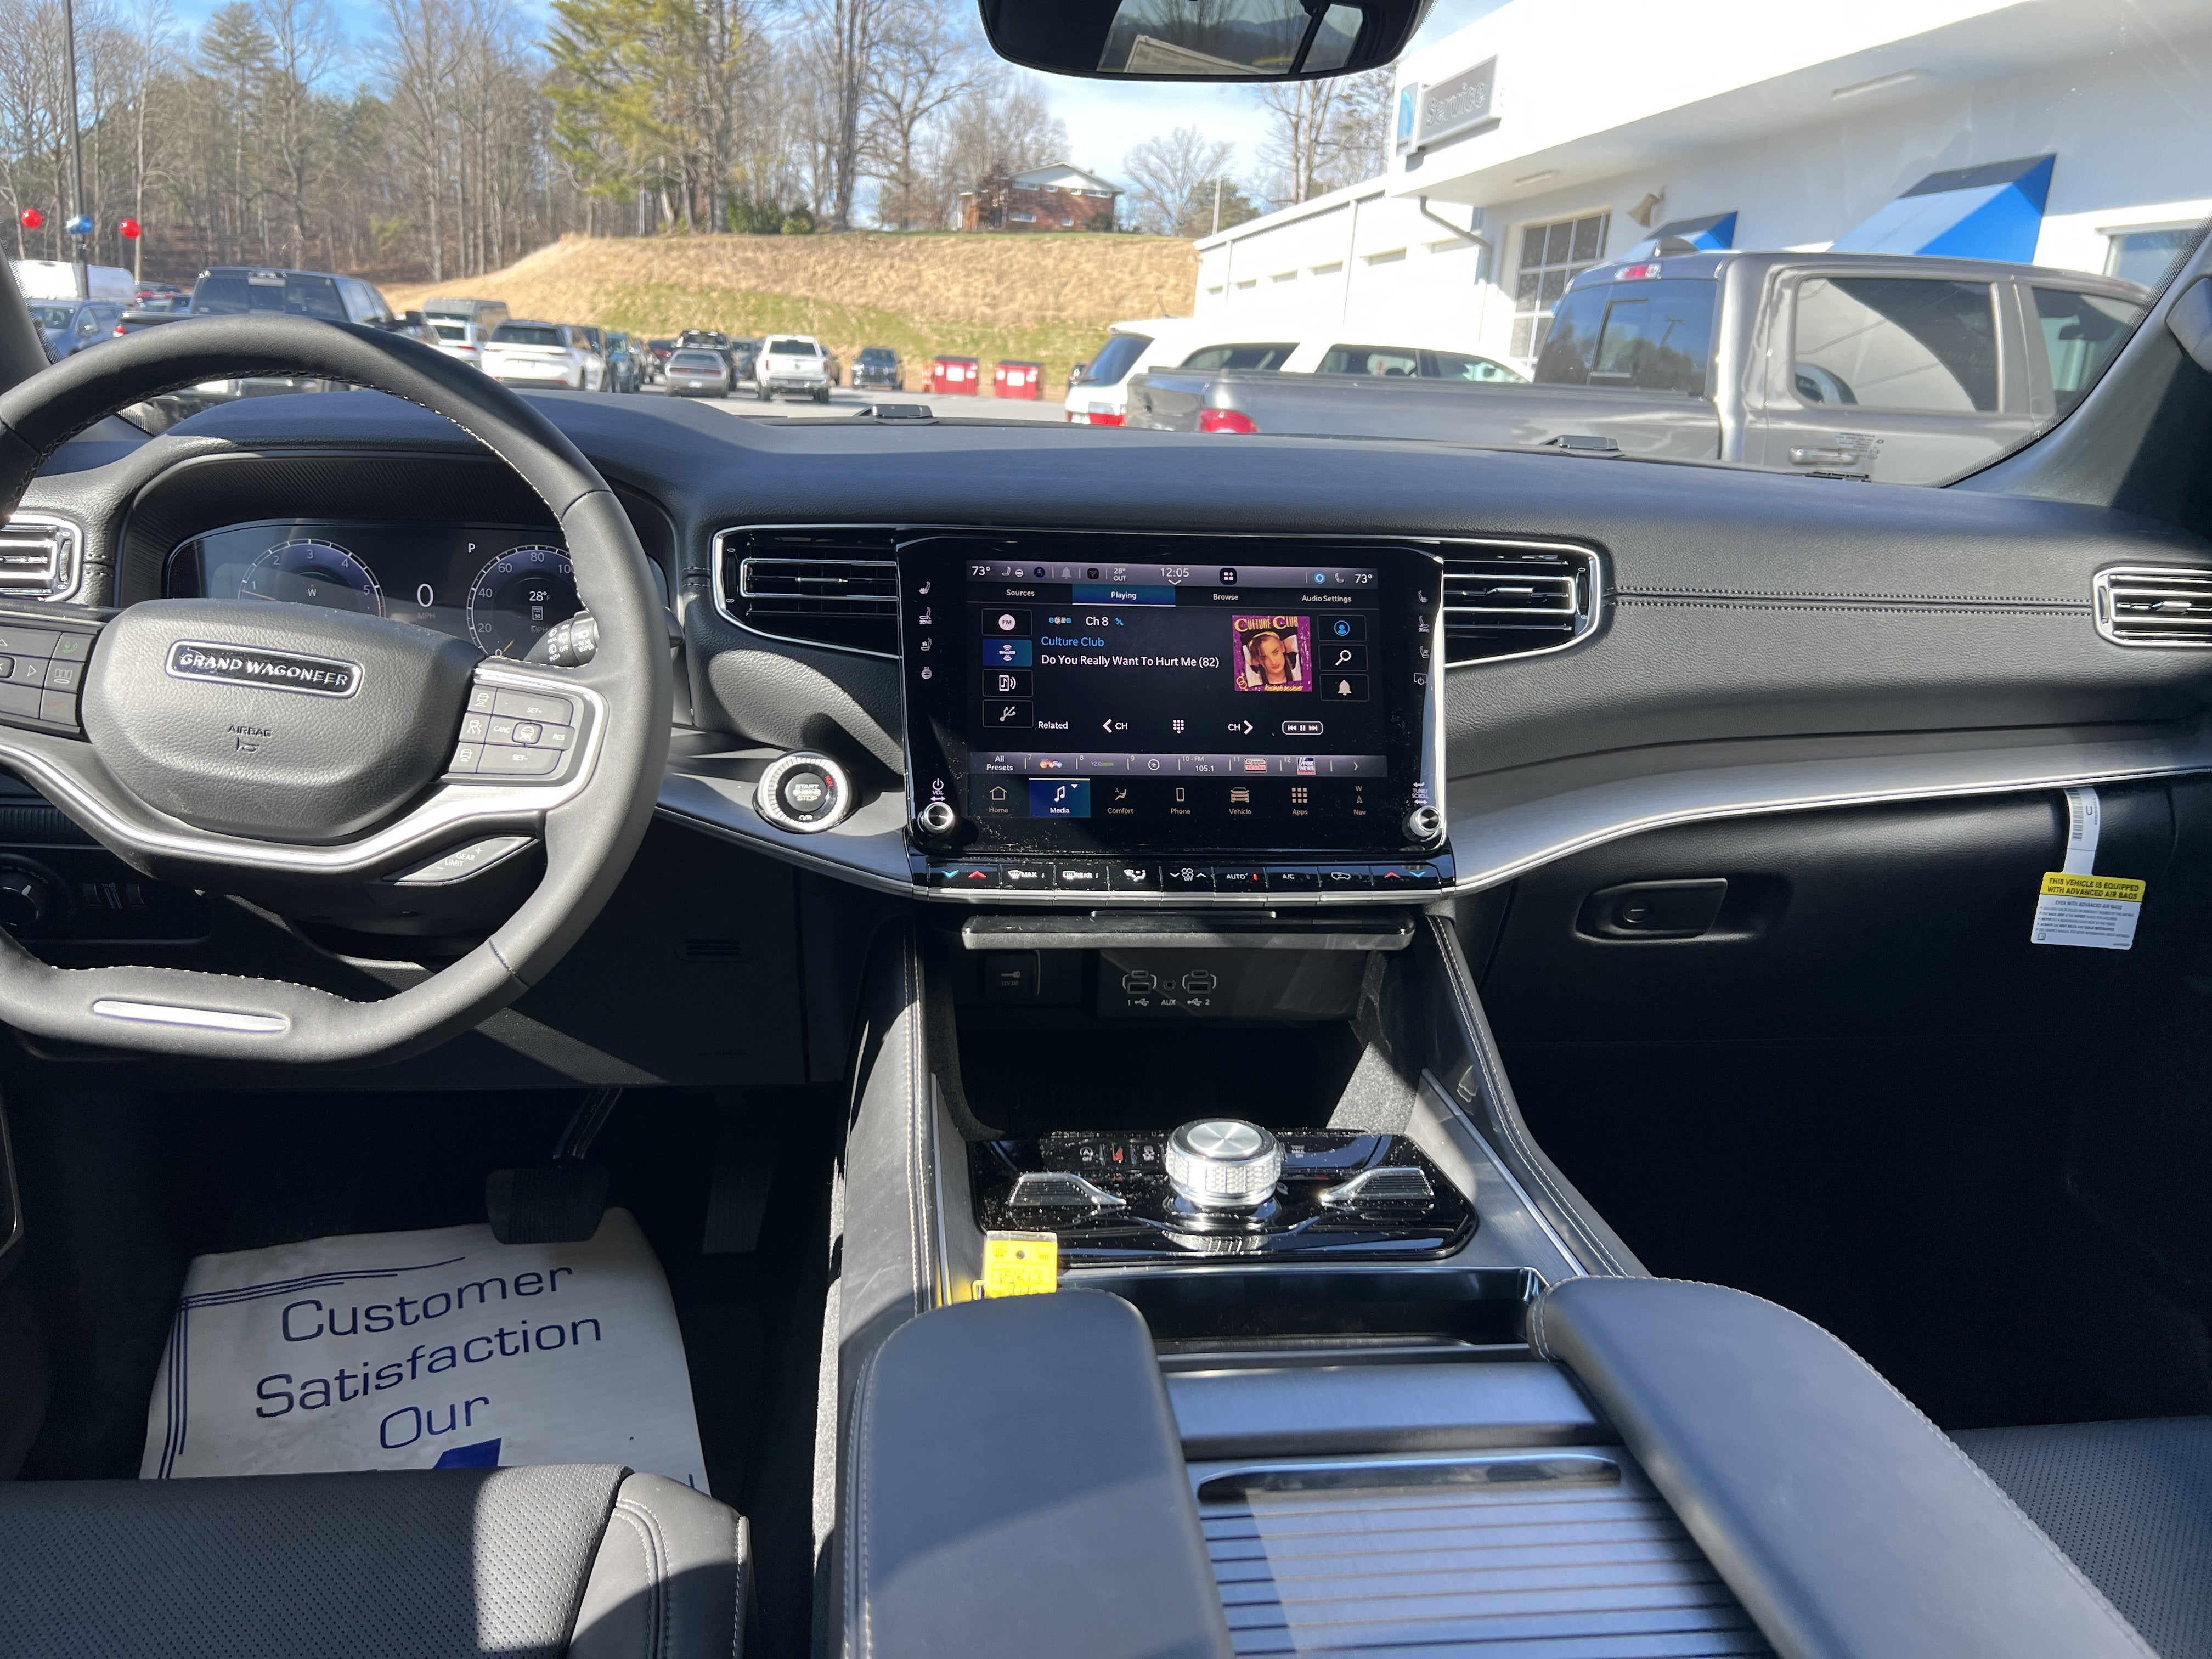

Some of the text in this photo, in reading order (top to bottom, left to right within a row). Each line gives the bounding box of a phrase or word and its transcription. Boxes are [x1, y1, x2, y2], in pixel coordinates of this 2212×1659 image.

[1425, 82, 1486, 128] Service
[468, 543, 476, 553] P
[307, 549, 313, 559] 3
[531, 552, 545, 562] 80
[273, 555, 280, 565] 2
[341, 558, 349, 568] 4
[498, 563, 512, 573] 60
[972, 566, 991, 576] 73°
[1160, 567, 1189, 578] 12:05
[1354, 573, 1373, 584] 73°
[251, 580, 257, 590] 1
[307, 588, 317, 596] W
[363, 585, 370, 596] 5
[417, 583, 434, 607] 0
[478, 588, 493, 598] 40
[1111, 591, 1137, 600] Playing
[1323, 595, 1352, 604] Settings
[417, 612, 436, 620] MPH
[1085, 616, 1109, 627] Ch 8
[478, 623, 492, 633] 20
[578, 639, 591, 647] REAR
[1041, 636, 1105, 647] Culture Club
[559, 645, 569, 653] OFF
[578, 644, 595, 653] WIPER
[549, 653, 561, 662] PUSH
[1041, 654, 1220, 669] Do You Really Want To Hurt Me (82)
[179, 650, 349, 686] GRAND WAGONEER
[493, 725, 512, 734] CANC
[1038, 721, 1068, 730] Related
[1115, 722, 1128, 730] CH
[1228, 723, 1241, 732] CH
[228, 725, 272, 737] AIRBAG
[986, 764, 1013, 772] Presets
[456, 852, 476, 861] GEAR
[444, 859, 464, 867] LIMIT
[2049, 877, 2064, 885] THIS
[2066, 879, 2094, 888] VEHICLE
[2104, 882, 2139, 892] EQUIPPED
[2047, 885, 2138, 900] WITH ADVANCED AIR BAGS
[280, 1266, 572, 1342] Customer
[255, 1316, 602, 1419] Satisfaction
[379, 1395, 489, 1450] Our
